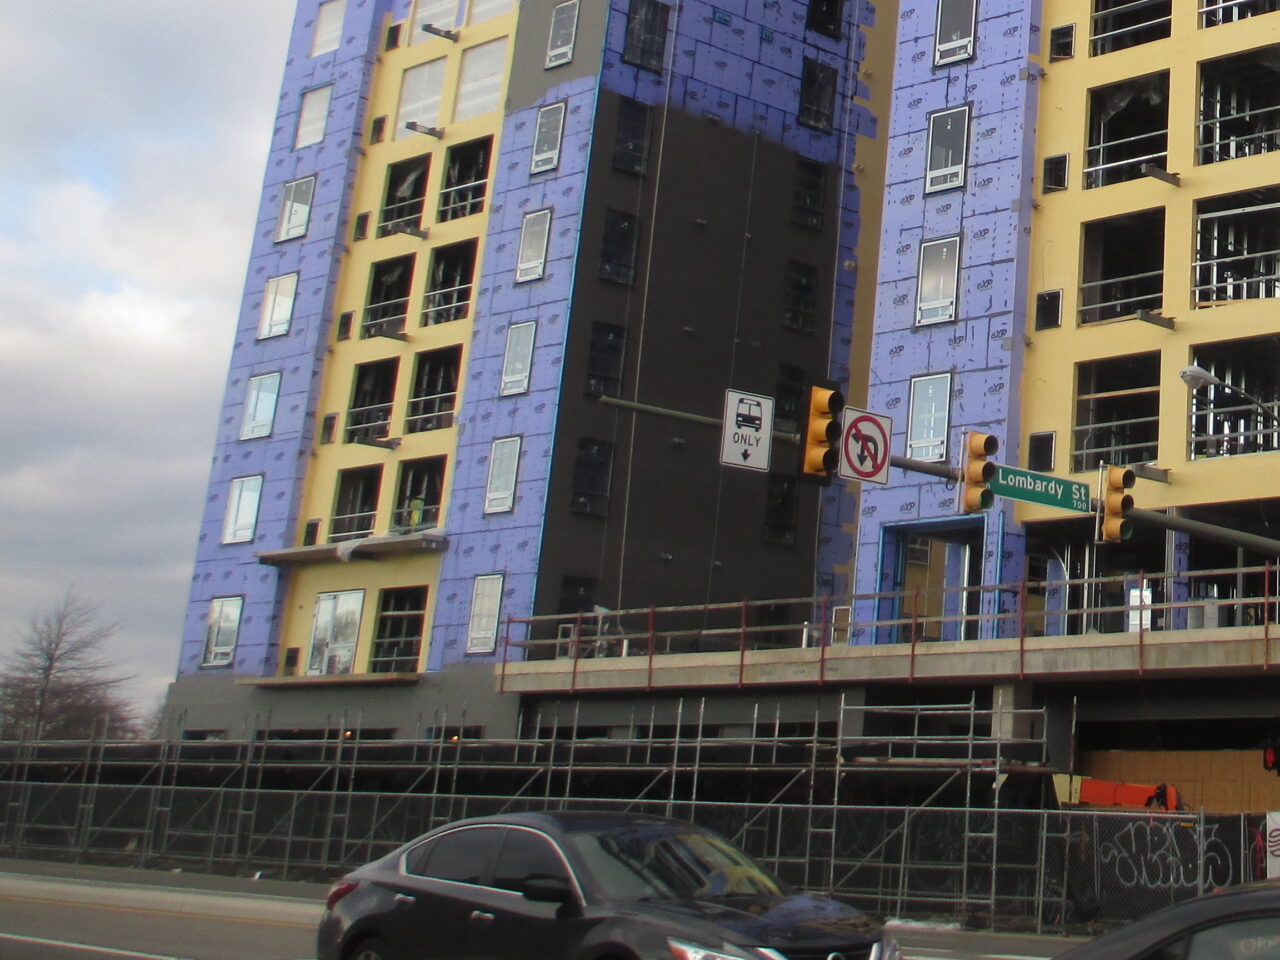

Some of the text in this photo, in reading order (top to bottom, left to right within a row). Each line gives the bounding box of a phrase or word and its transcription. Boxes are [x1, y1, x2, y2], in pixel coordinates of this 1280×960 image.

[733, 432, 762, 447] ONLY
[999, 468, 1086, 500] Lombardy St
[1072, 500, 1086, 510] 700
